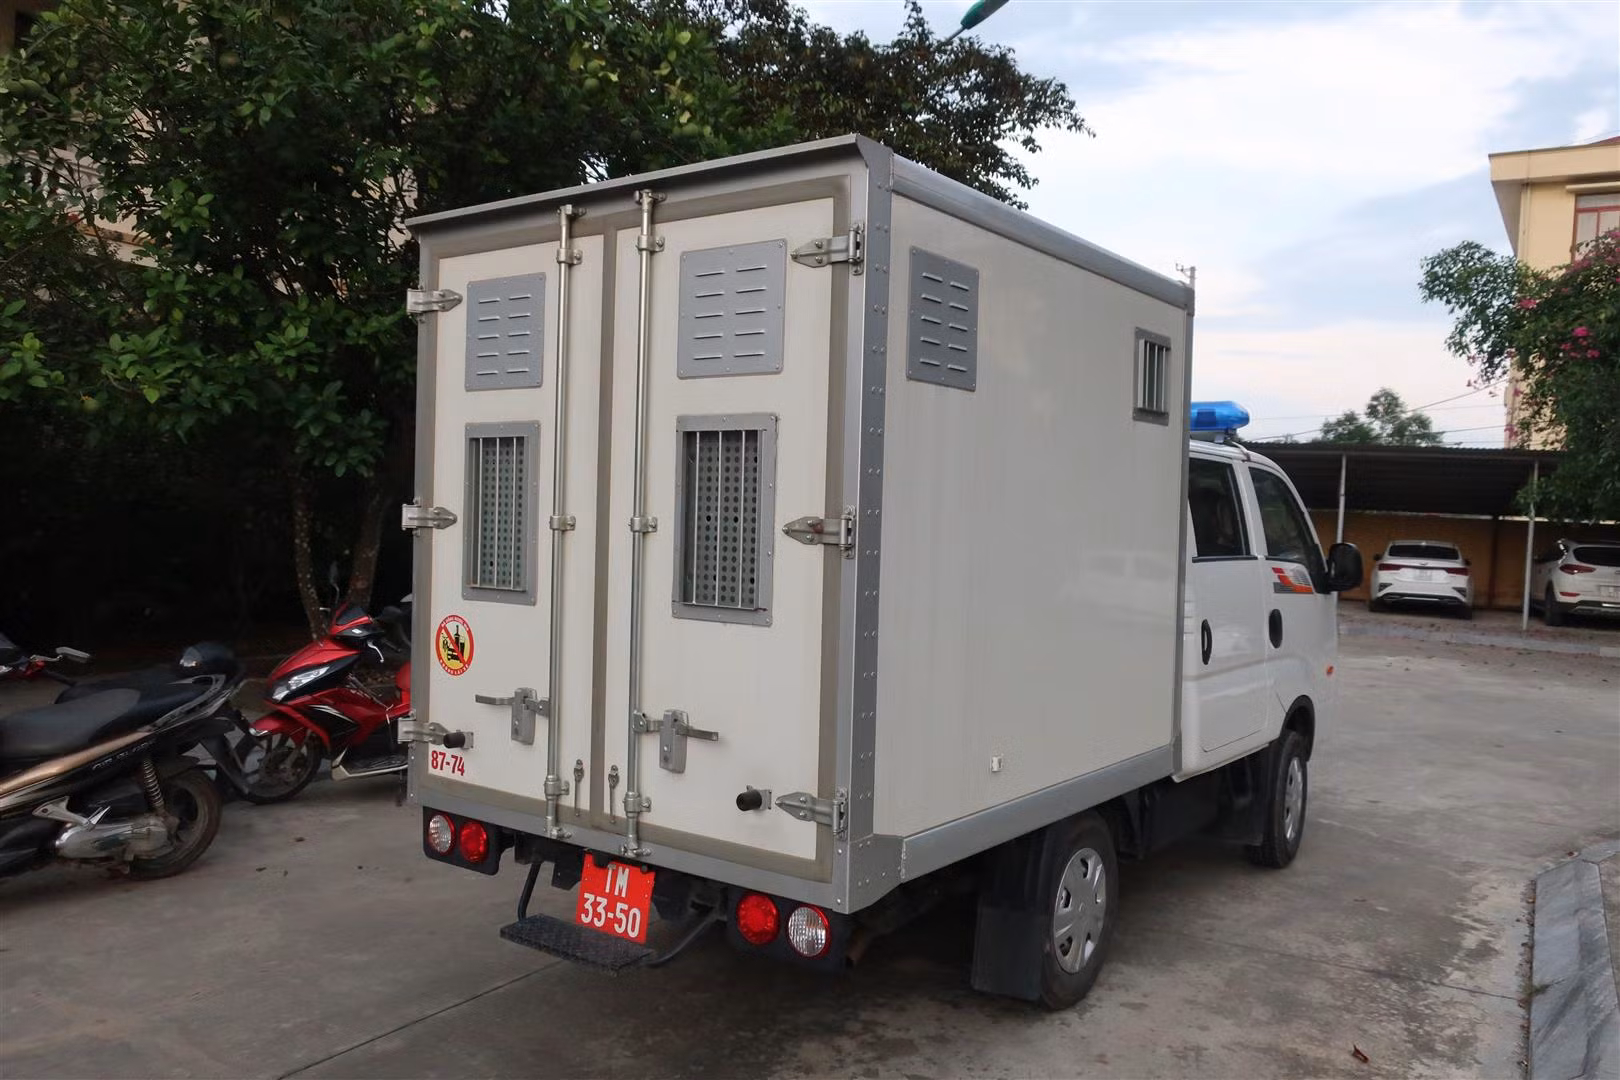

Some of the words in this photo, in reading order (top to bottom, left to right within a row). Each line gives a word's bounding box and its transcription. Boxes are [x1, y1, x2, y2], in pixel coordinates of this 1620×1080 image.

[431, 750, 465, 776] 87-74
[605, 864, 630, 898] TM
[580, 892, 641, 938] 33-50
